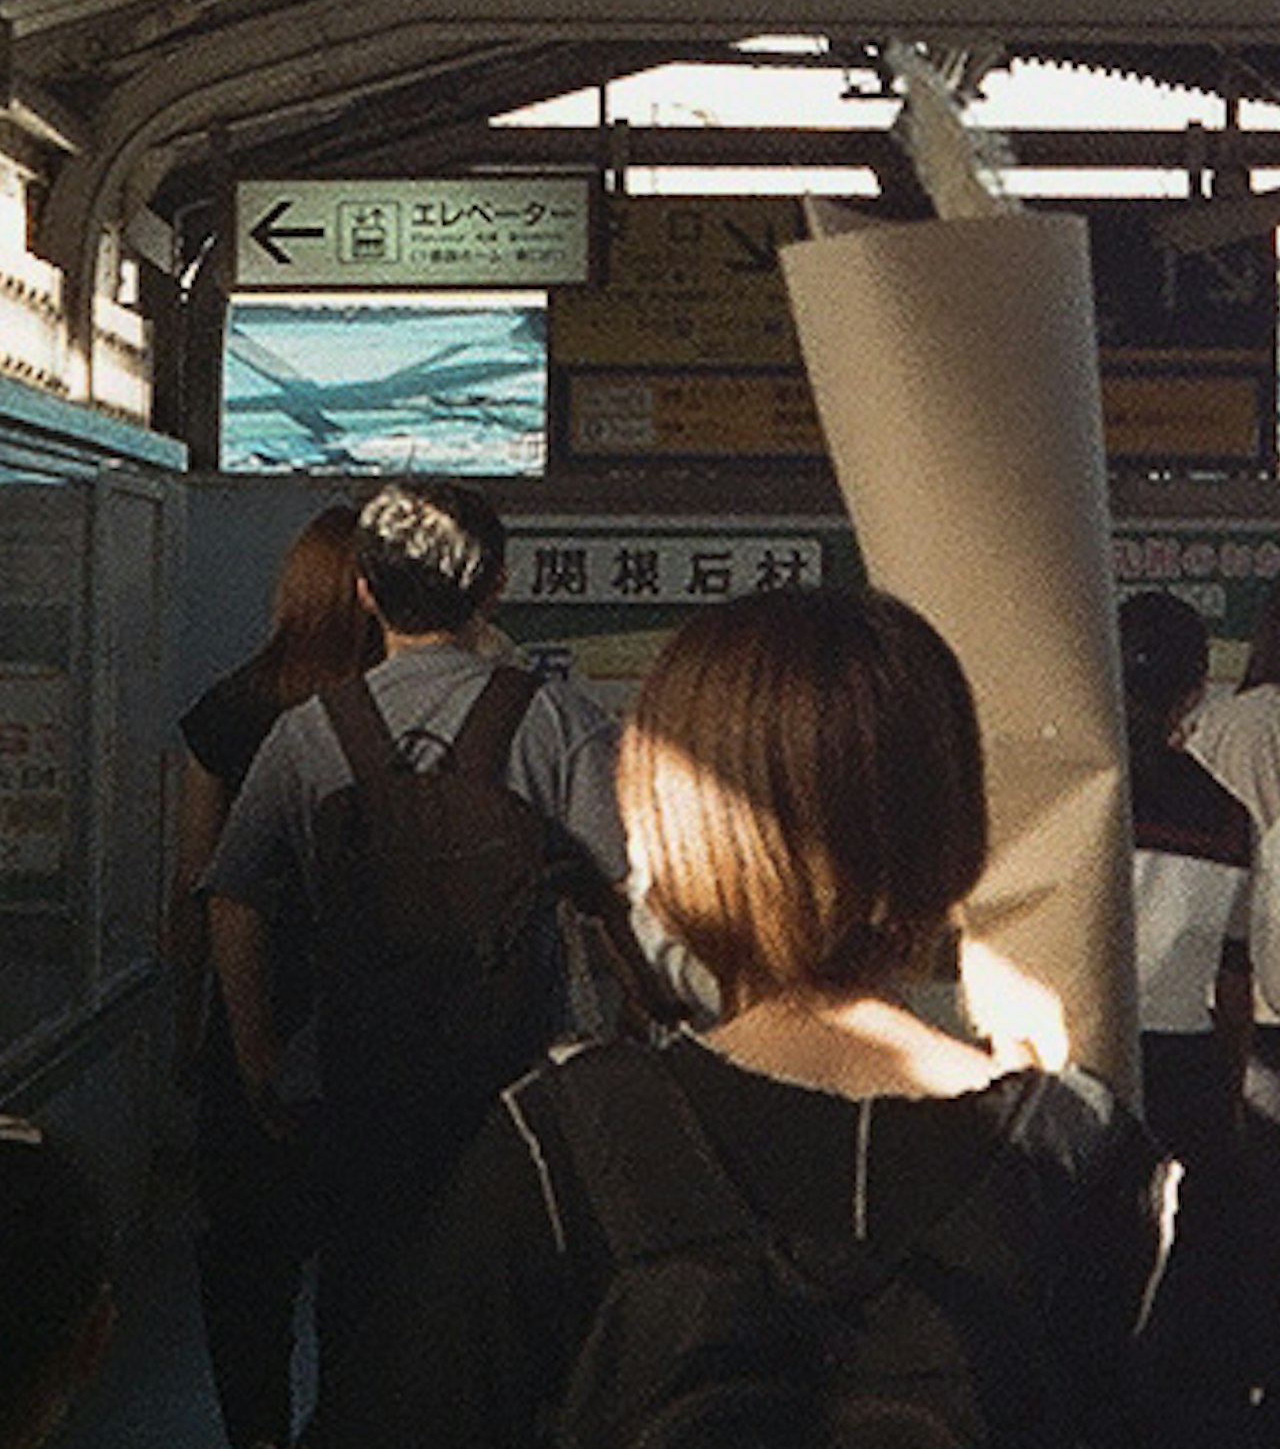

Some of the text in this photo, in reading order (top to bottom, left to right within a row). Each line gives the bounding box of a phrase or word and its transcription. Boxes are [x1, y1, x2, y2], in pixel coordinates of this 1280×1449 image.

[412, 202, 577, 227] エレベーター
[531, 548, 809, 595] 関根石材
